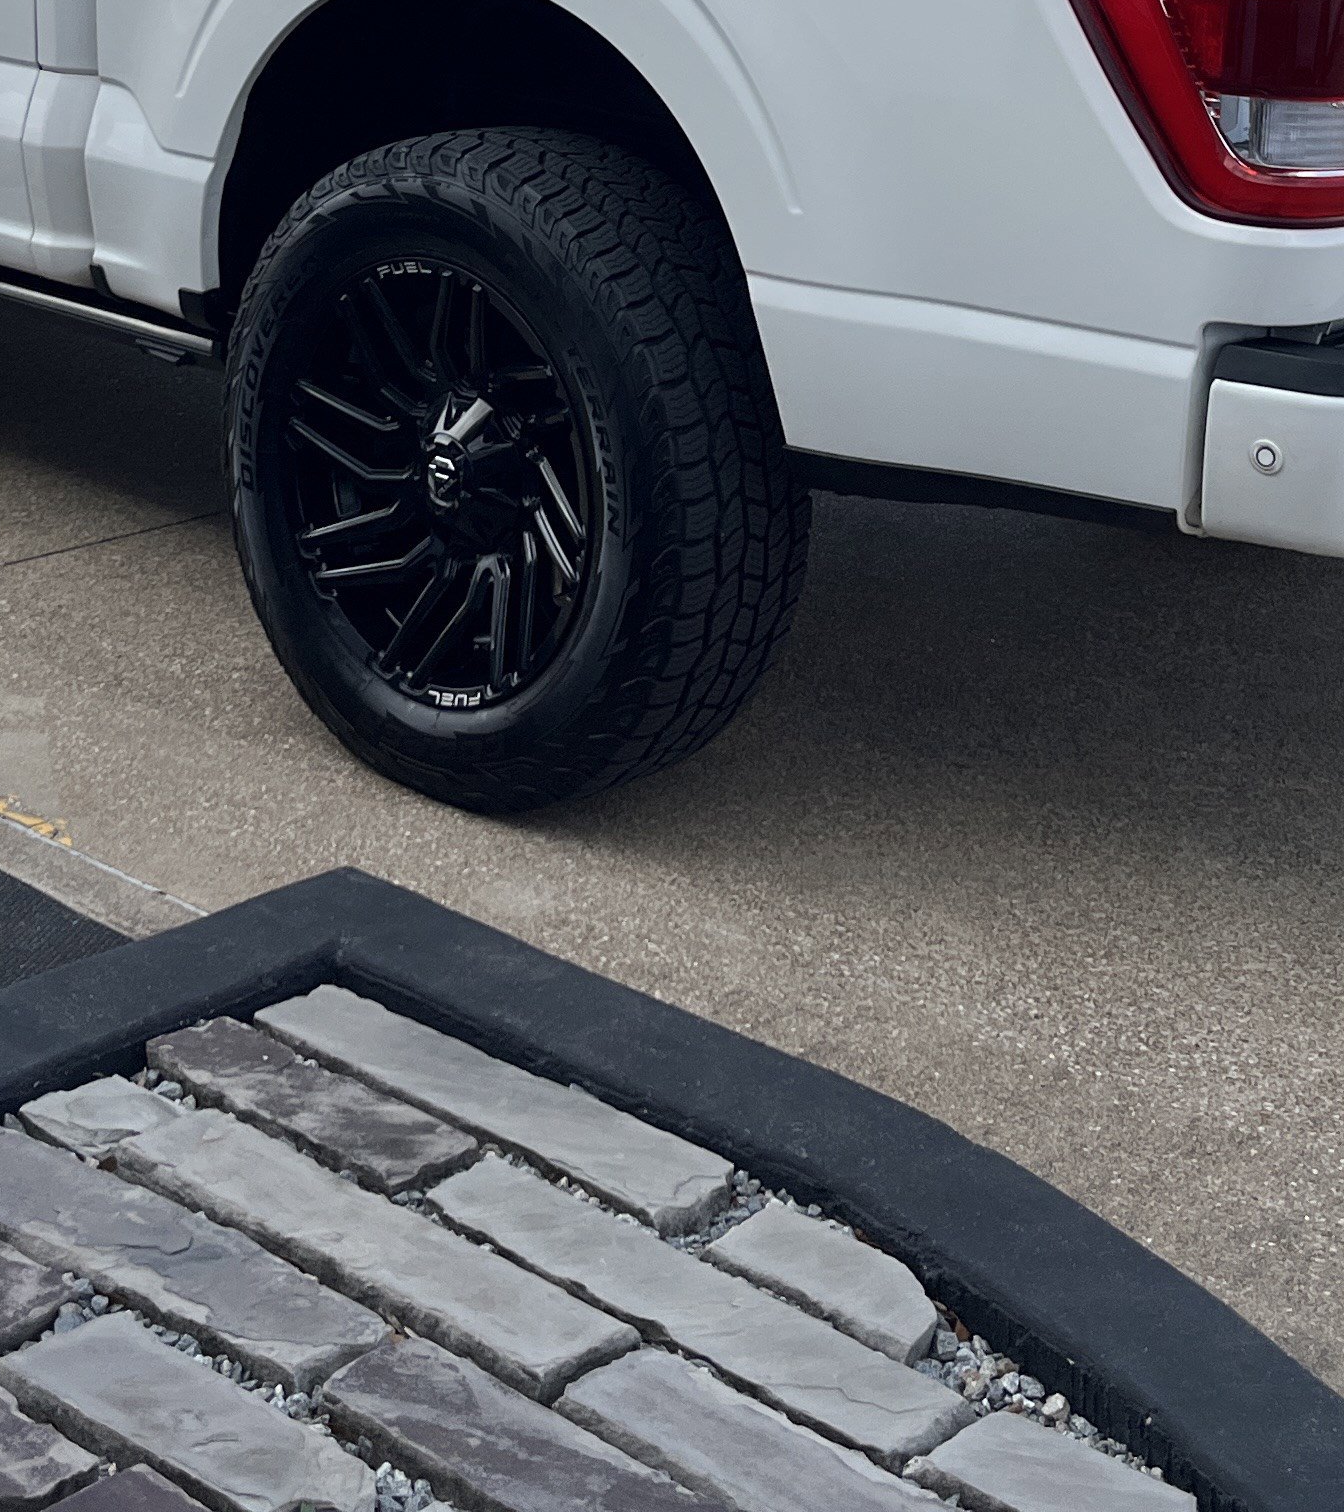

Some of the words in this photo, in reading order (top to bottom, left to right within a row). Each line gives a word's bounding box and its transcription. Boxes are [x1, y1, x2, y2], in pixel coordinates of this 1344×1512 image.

[376, 261, 432, 280] FUEL
[563, 338, 622, 536] TERRAIN
[427, 690, 481, 707] FUEL
